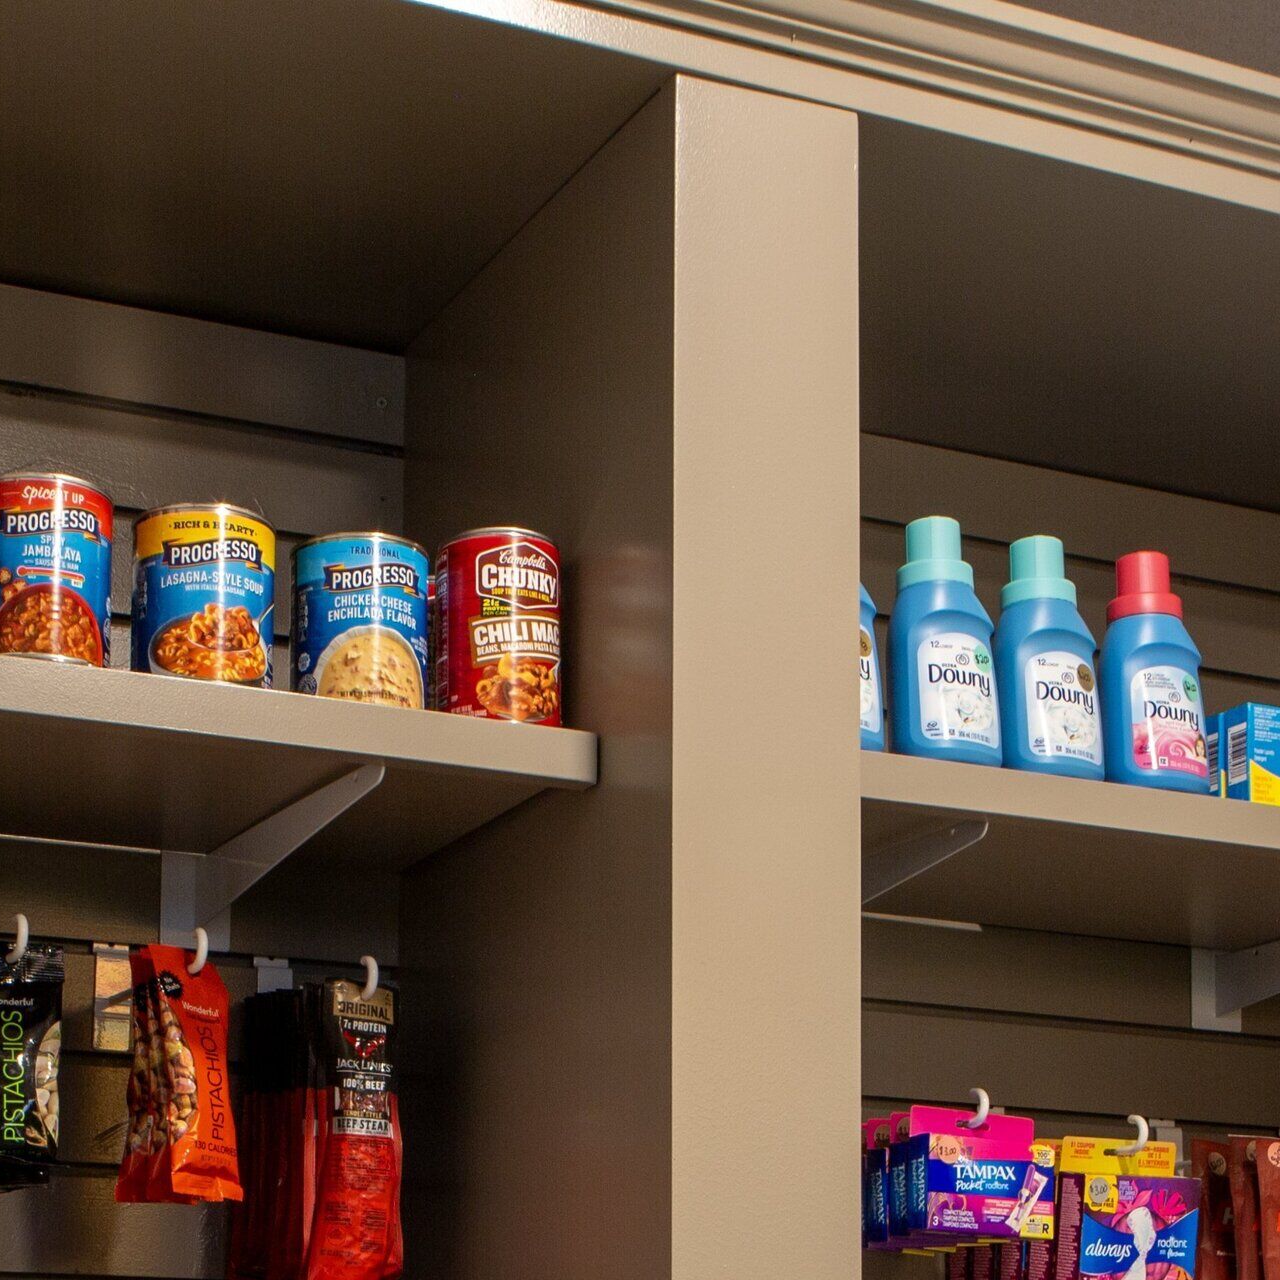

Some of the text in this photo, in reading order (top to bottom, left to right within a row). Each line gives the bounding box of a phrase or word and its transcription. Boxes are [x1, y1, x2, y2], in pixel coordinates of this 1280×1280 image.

[72, 493, 85, 504] UP
[174, 521, 200, 529] RICH
[171, 541, 256, 564] PROGRESSO
[499, 549, 547, 570] Campbell's
[244, 578, 263, 595] SOUP
[332, 566, 414, 589] PROGRESSO
[482, 564, 556, 599] CHUNKY
[335, 595, 412, 615] CHICKEN CHEESE
[328, 607, 416, 630] ENCHILADA FLAVOR
[474, 622, 560, 646] CHILI MAC
[928, 663, 991, 697] Downy
[1036, 680, 1094, 715] Downy
[1144, 700, 1199, 732] Downy
[182, 1000, 219, 1018] Wonderful
[353, 1022, 387, 1033] PROTEIN
[337, 1058, 360, 1070] JACK
[1, 1010, 25, 1142] PISTACHIOS
[199, 1026, 224, 1141] PISTACHIOS
[365, 1080, 385, 1090] BEEF
[360, 1119, 389, 1131] STEAK
[194, 1140, 206, 1150] 130
[953, 1164, 1016, 1181] TAMPAX
[917, 1155, 926, 1212] TAMPAX
[956, 1180, 986, 1192] Pocket
[876, 1168, 885, 1224] TAMPAX
[933, 1216, 938, 1226] 3
[1042, 1224, 1049, 1234] R
[1085, 1238, 1133, 1265] always
[1157, 1237, 1188, 1248] radiant
